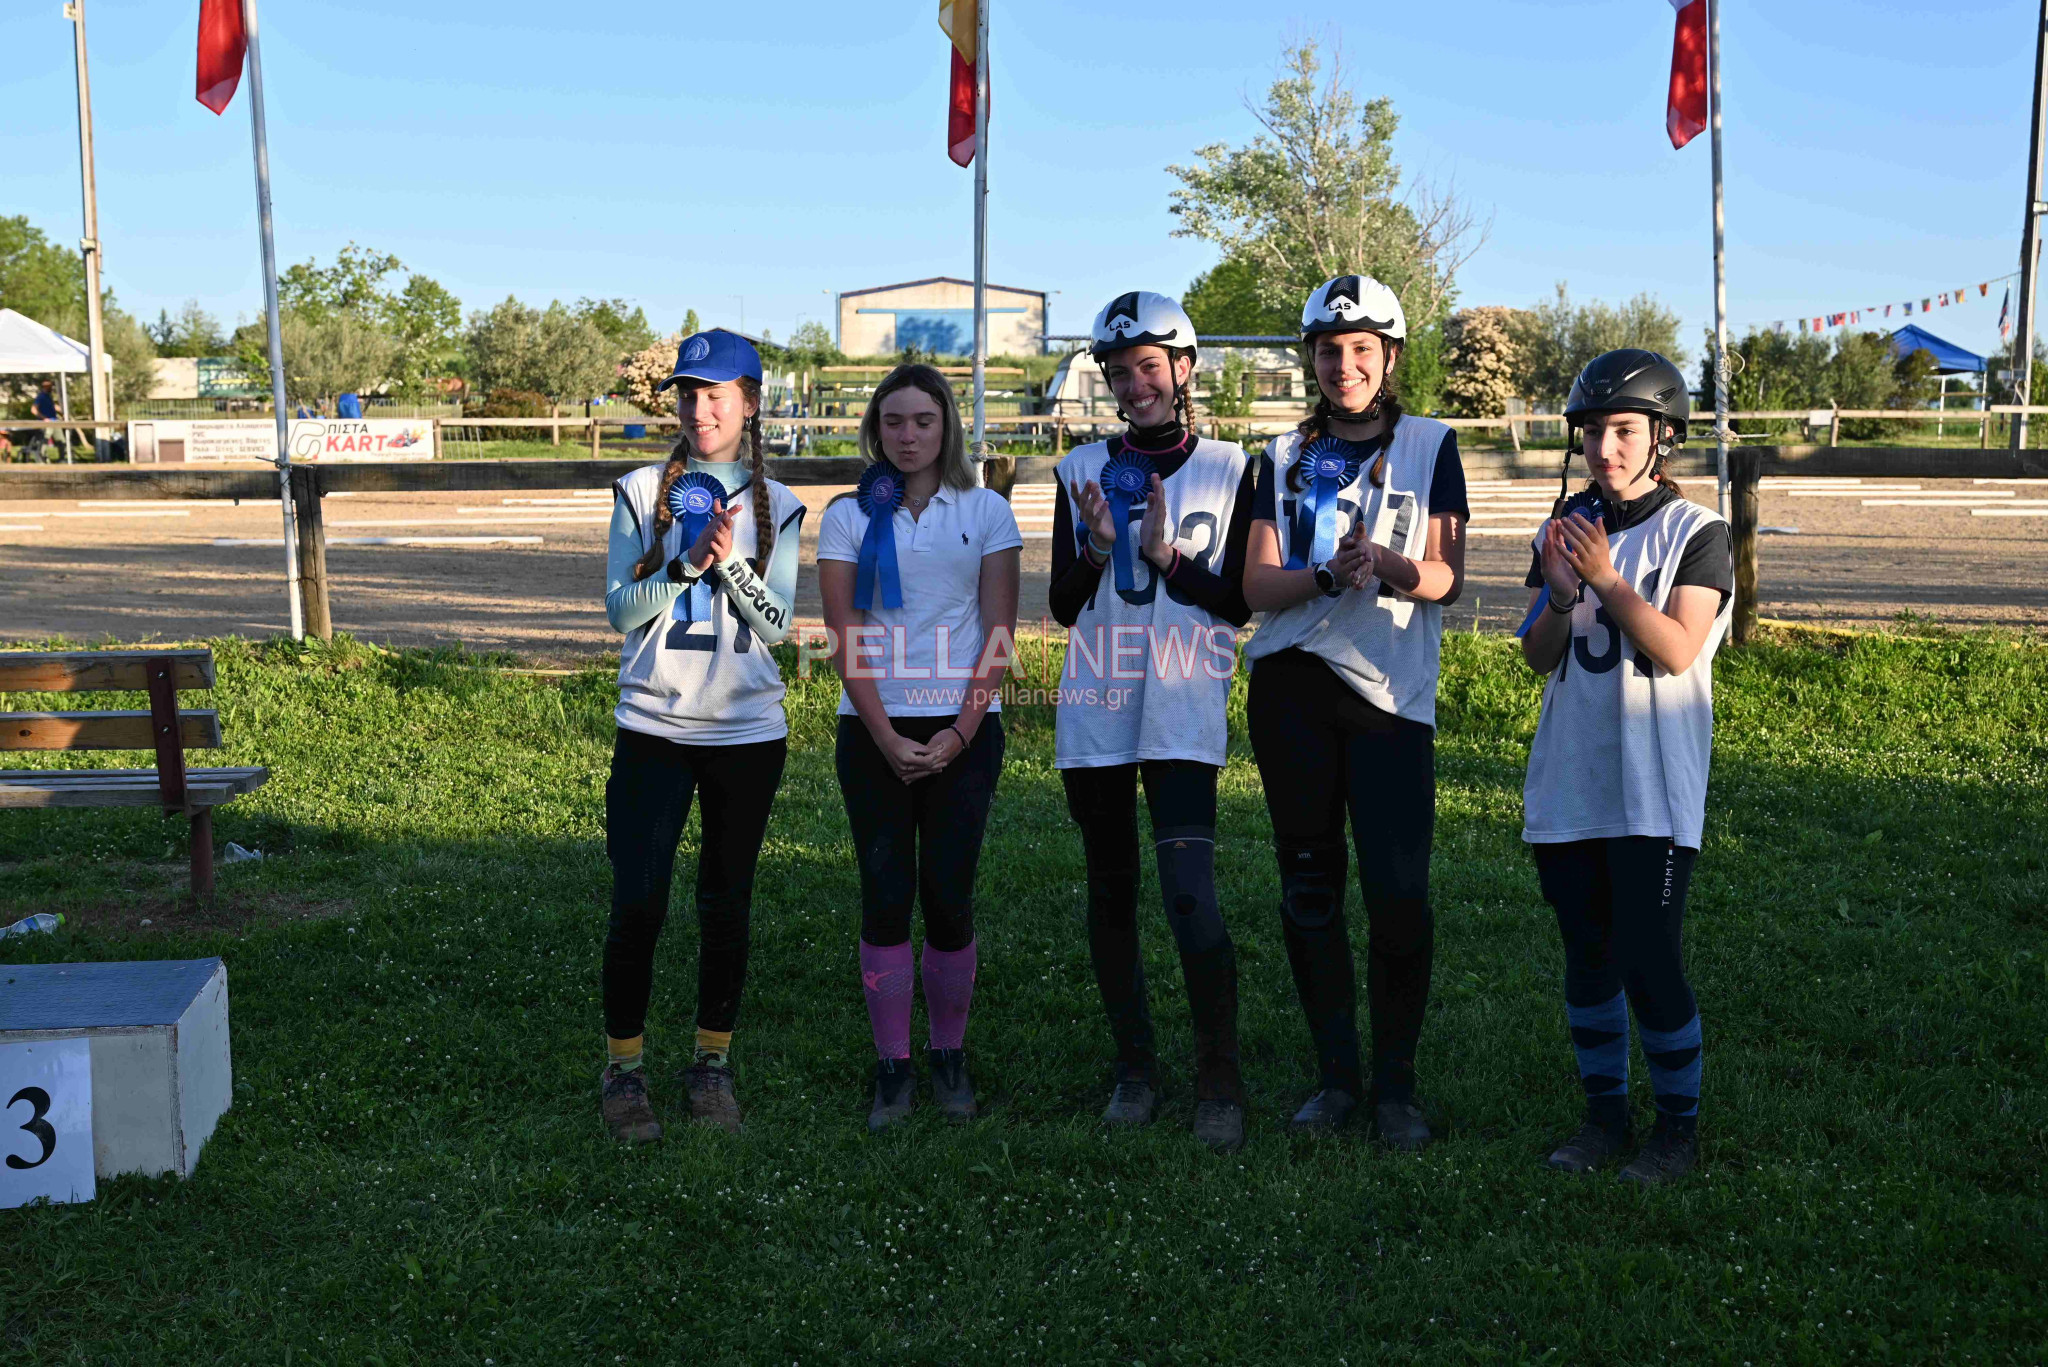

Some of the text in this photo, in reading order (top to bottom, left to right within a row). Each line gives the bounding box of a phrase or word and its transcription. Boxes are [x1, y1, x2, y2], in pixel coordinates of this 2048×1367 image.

[1328, 302, 1351, 311] LAS
[1109, 320, 1131, 331] LAS
[327, 423, 369, 434] ΠΙΣΤΑ
[325, 434, 388, 452] KART
[727, 560, 787, 631] mistral
[1661, 858, 1674, 907] TOMMY
[5, 1085, 57, 1170] 3
